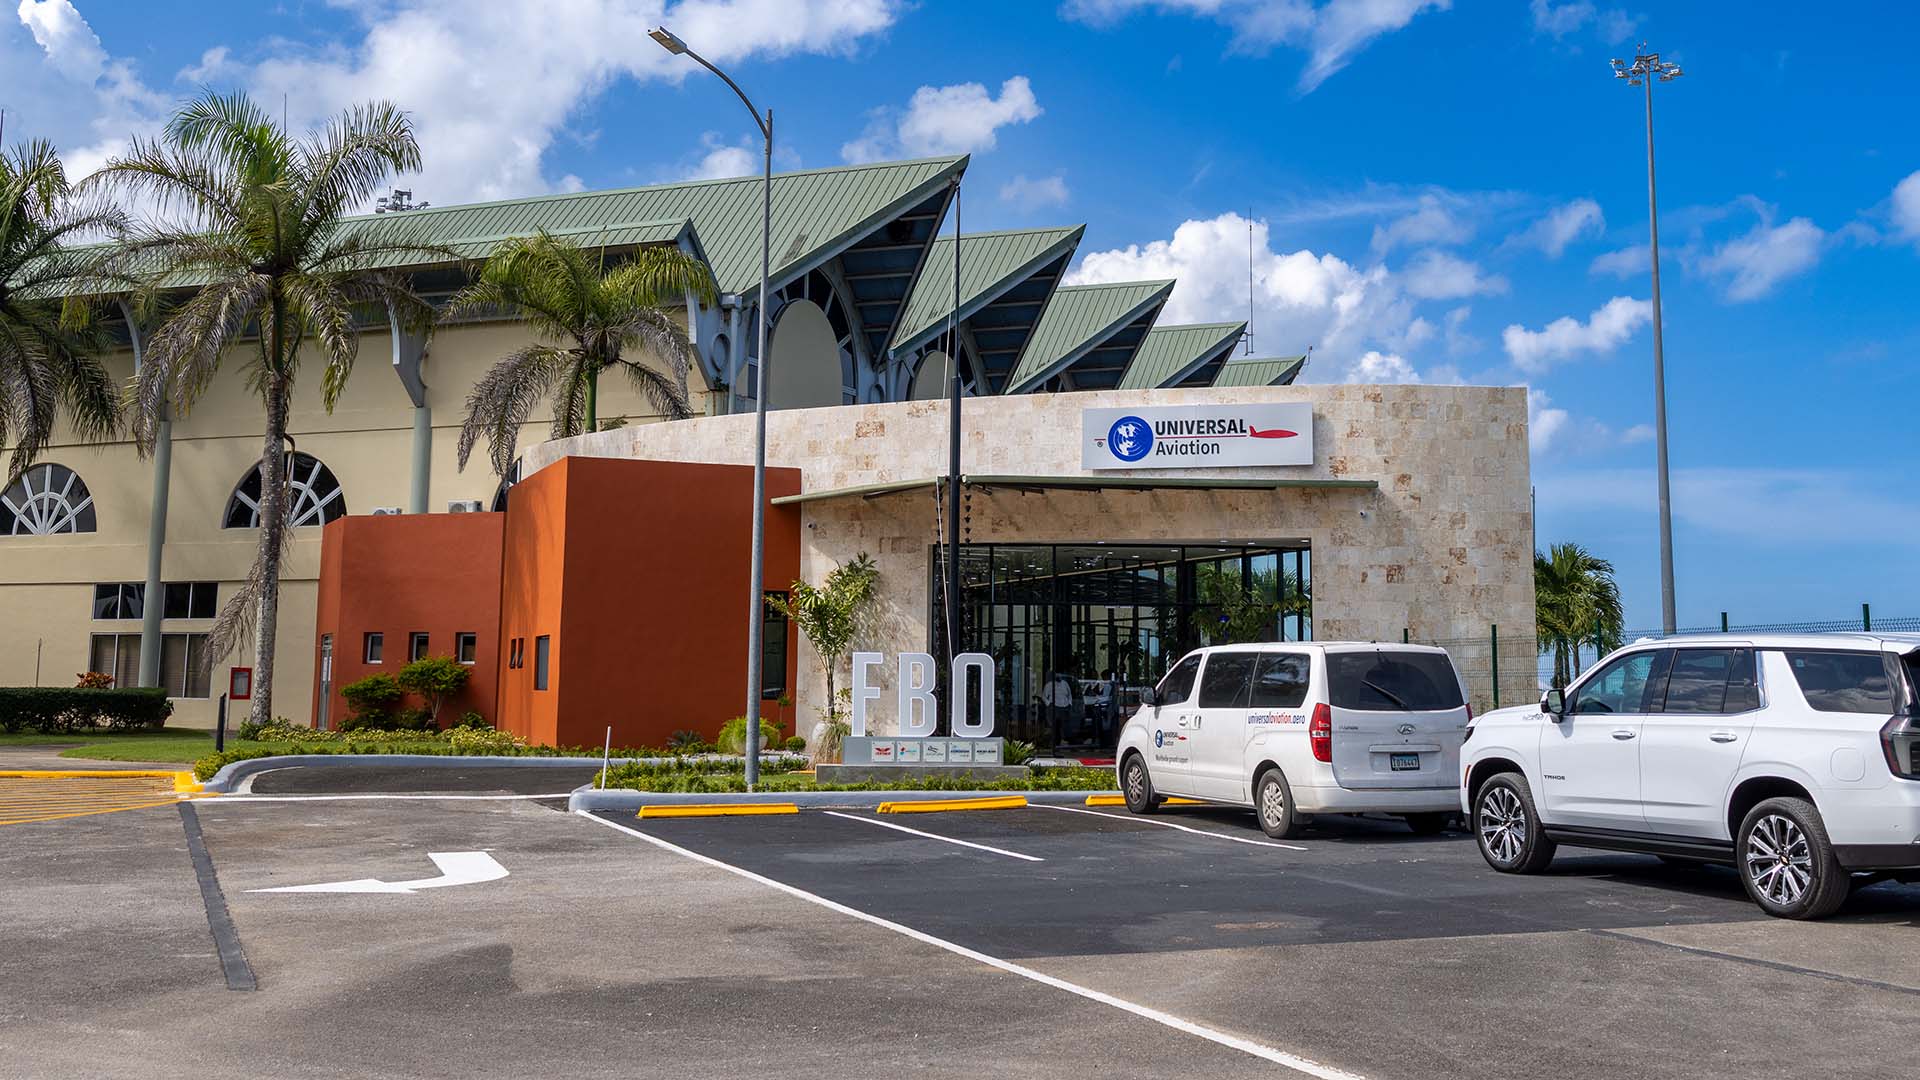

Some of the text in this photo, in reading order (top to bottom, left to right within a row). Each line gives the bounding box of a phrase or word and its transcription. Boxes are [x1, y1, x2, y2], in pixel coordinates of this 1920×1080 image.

[1155, 419, 1247, 435] UNIVERSAL
[1155, 441, 1220, 455] Aviation
[851, 652, 995, 738] FBO
[1248, 711, 1306, 724] universalaviation.aero
